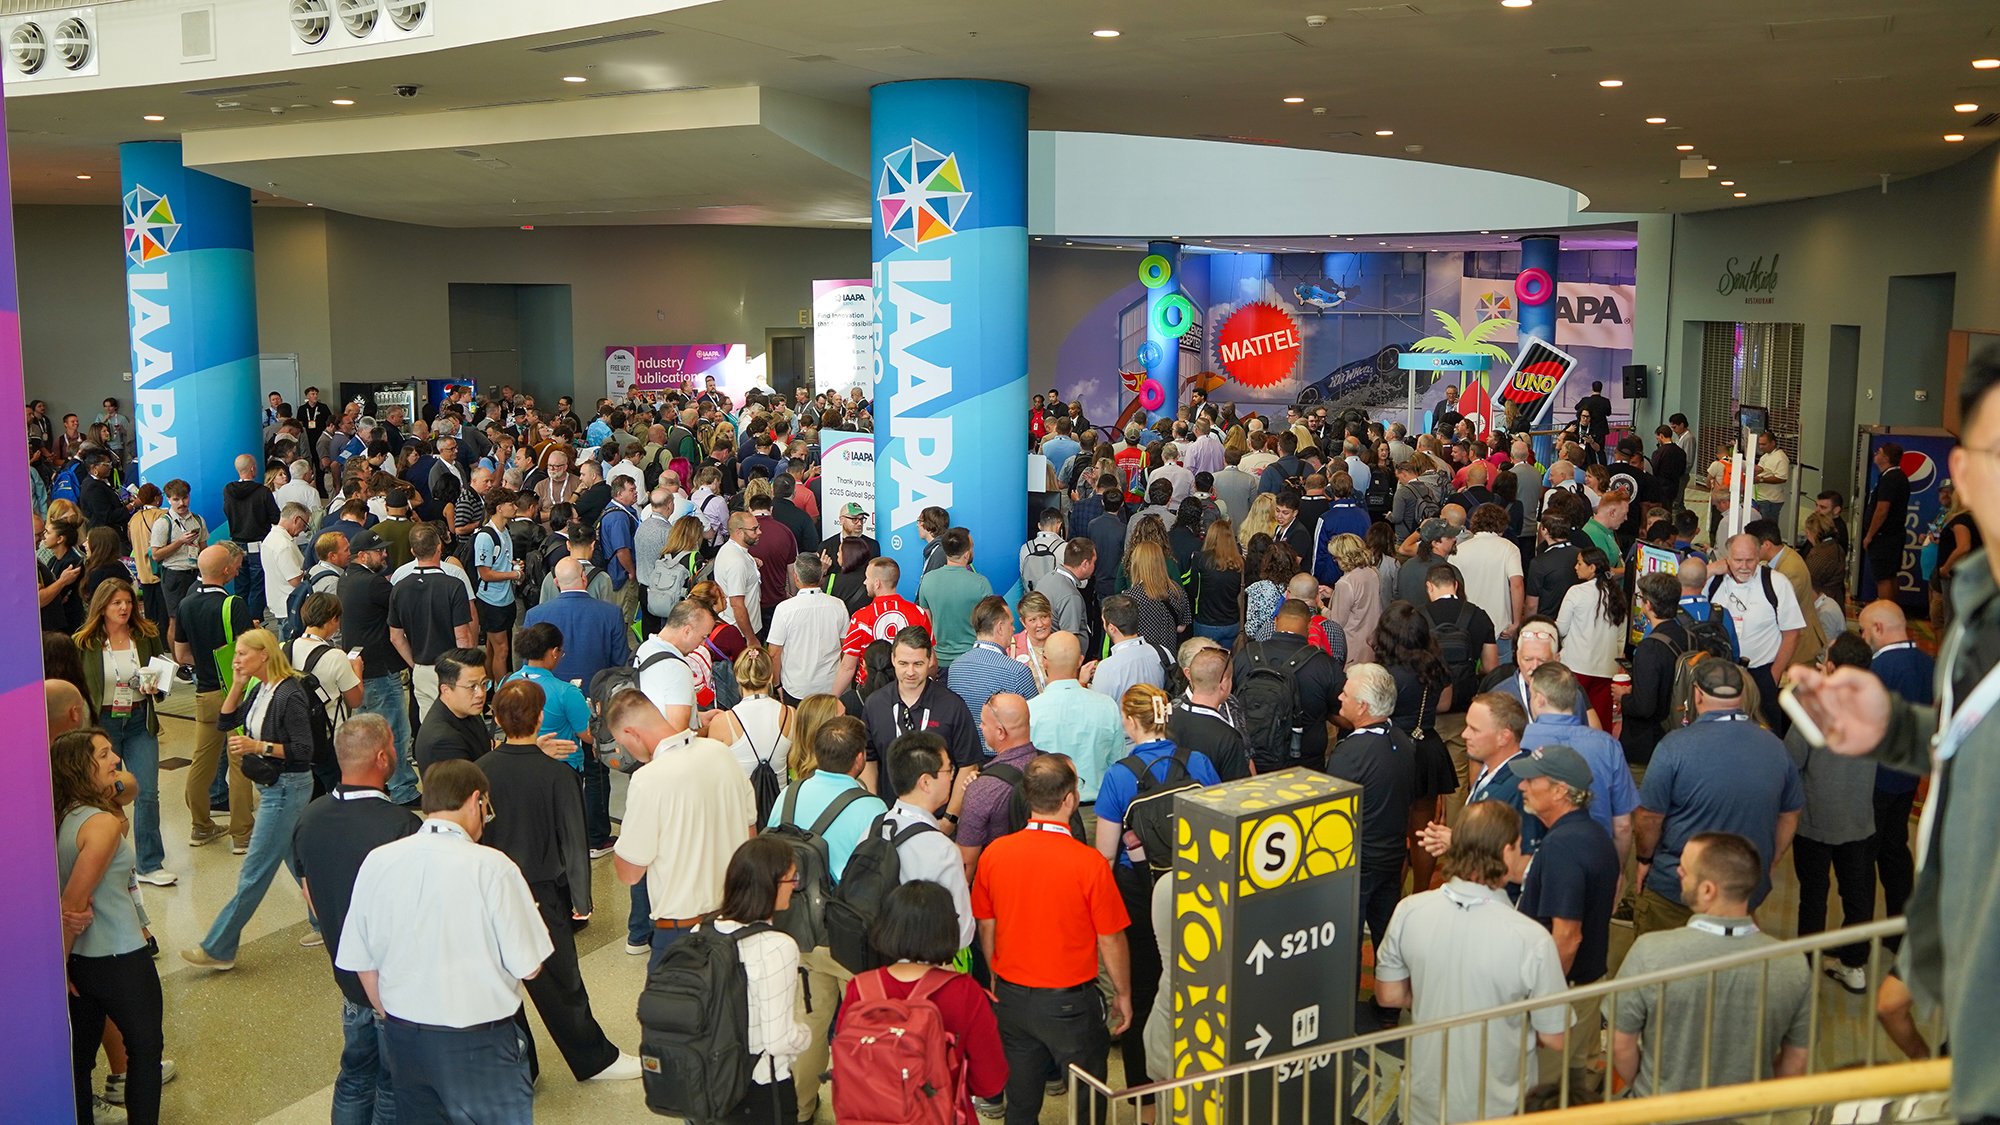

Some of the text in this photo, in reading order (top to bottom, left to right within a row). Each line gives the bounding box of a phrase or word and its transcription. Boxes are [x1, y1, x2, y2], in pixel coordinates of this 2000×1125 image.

[1716, 253, 1779, 297] Southside
[843, 293, 866, 301] IAAPA
[873, 262, 884, 384] EXPO
[1220, 328, 1300, 364] MATTEL
[128, 271, 178, 474] IAAPA
[637, 357, 684, 371] ndustry
[889, 257, 953, 531] IAAPA
[1511, 371, 1557, 394] UNO
[851, 451, 874, 462] IAAPA
[829, 488, 844, 497] 2025
[845, 489, 863, 498] Global
[837, 476, 853, 485] Thank
[1648, 556, 1676, 576] LIFE
[1263, 831, 1287, 872] S
[1280, 921, 1336, 960] S210
